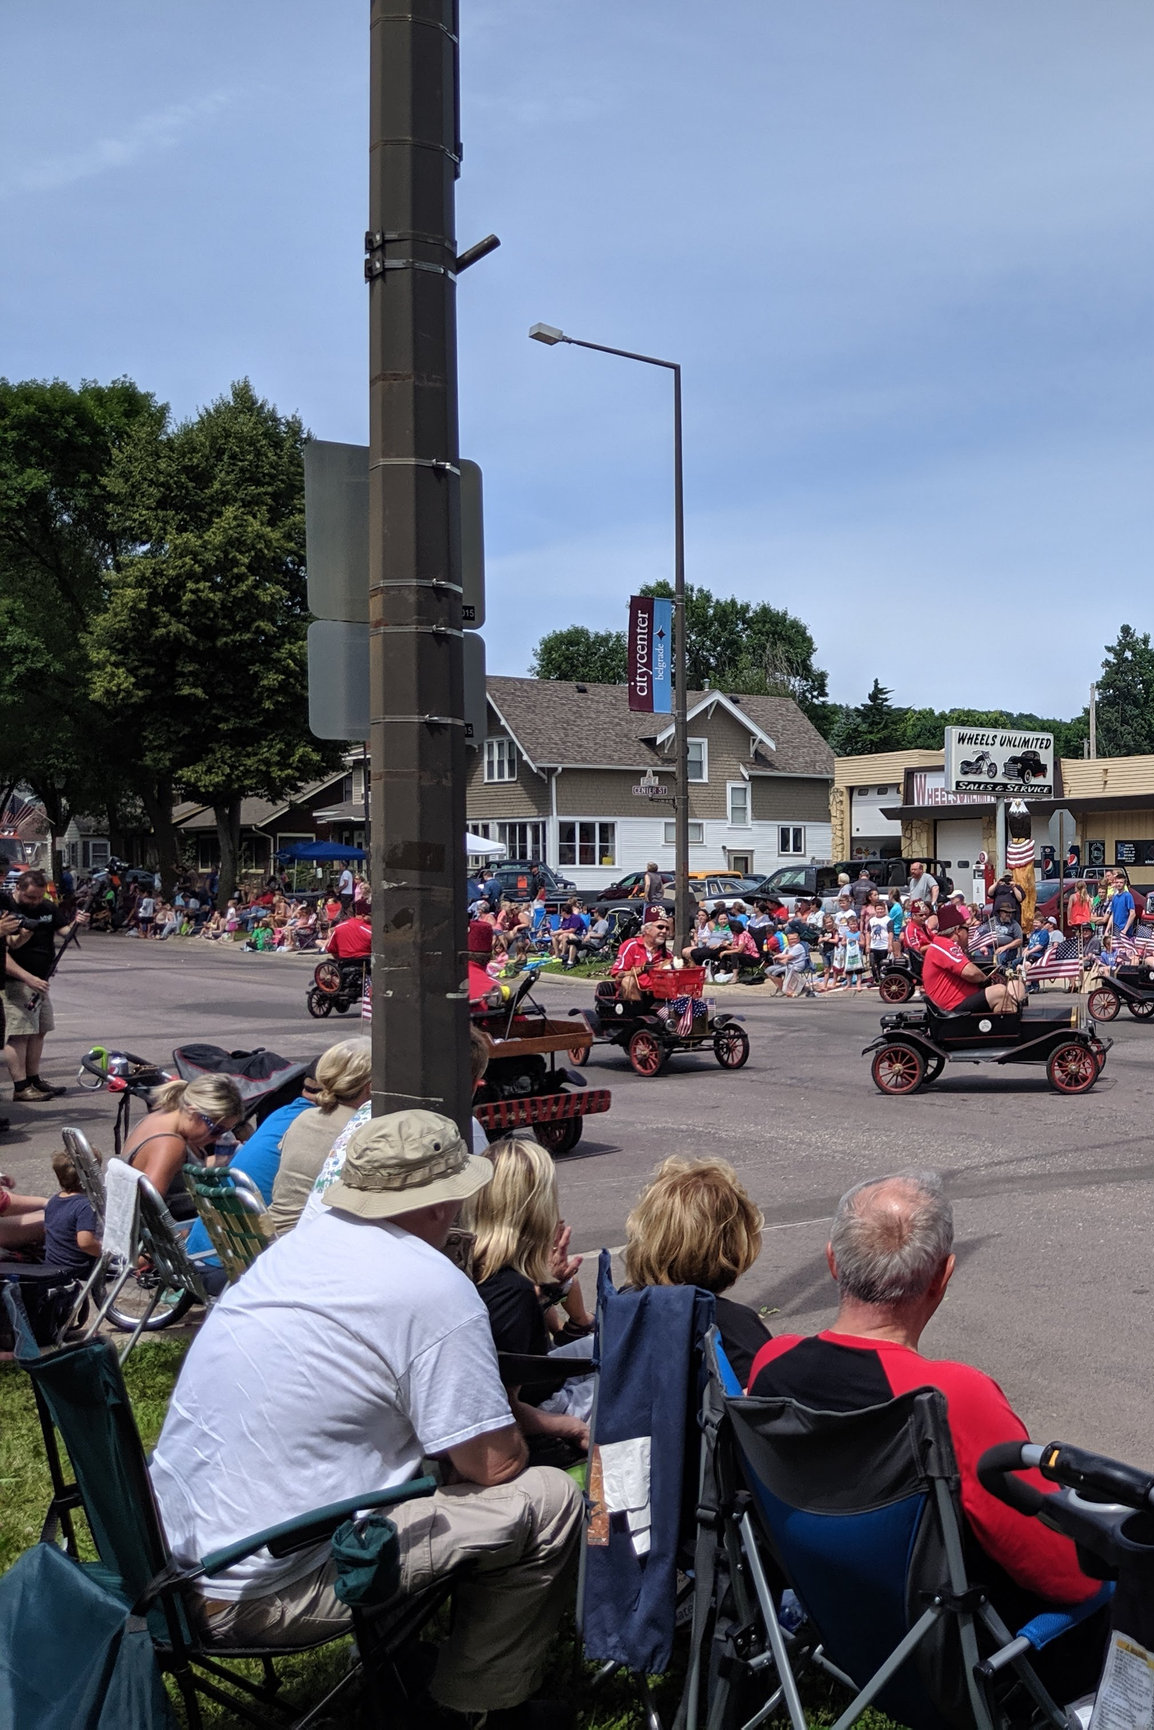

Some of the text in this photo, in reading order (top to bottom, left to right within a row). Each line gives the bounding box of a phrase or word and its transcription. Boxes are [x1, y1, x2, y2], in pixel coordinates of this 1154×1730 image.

[630, 610, 653, 696] citycenter
[655, 643, 666, 680] belgrade
[957, 731, 1052, 750] WHEELS UNLIMITED
[634, 787, 666, 795] CENTER ST
[957, 781, 1051, 794] SALES & SERVICE
